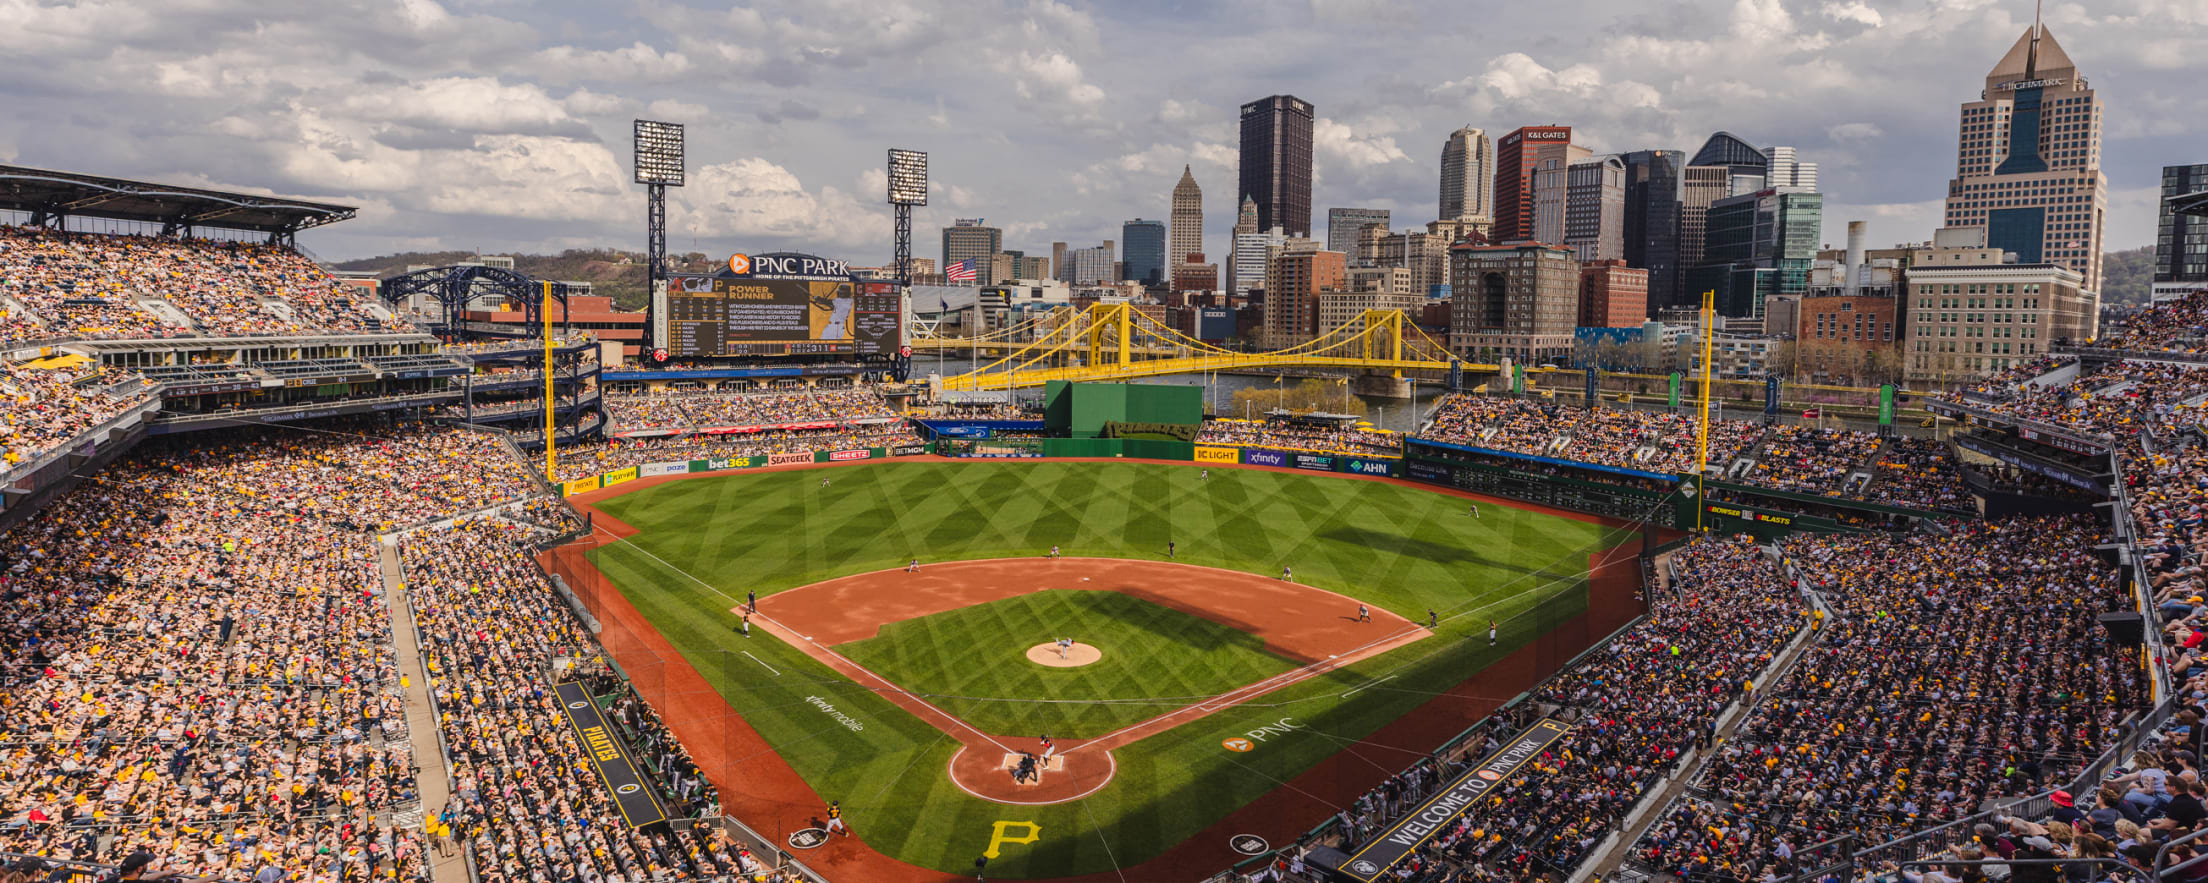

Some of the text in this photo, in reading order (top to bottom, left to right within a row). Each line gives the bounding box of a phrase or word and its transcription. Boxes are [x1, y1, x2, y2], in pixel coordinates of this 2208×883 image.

[753, 256, 850, 276] PNC PARK
[729, 285, 769, 293] POWER
[729, 292, 775, 300] RUNNER
[833, 450, 868, 459] SHEETZ
[895, 447, 924, 455] BETMGM
[1209, 451, 1235, 460] LIGHT
[709, 457, 750, 469] bet365
[771, 454, 811, 465] SEATGEEK
[1250, 452, 1280, 464] xfinity
[666, 463, 686, 472] paze
[1363, 462, 1387, 474] AHN
[1711, 506, 1741, 516] BOWSER
[1761, 515, 1791, 525] BLASTS
[1243, 717, 1306, 742] PNC
[583, 725, 620, 762] PIRATES
[1388, 738, 1542, 846] WELCOME TO PNC PARK
[983, 820, 1042, 859] P
